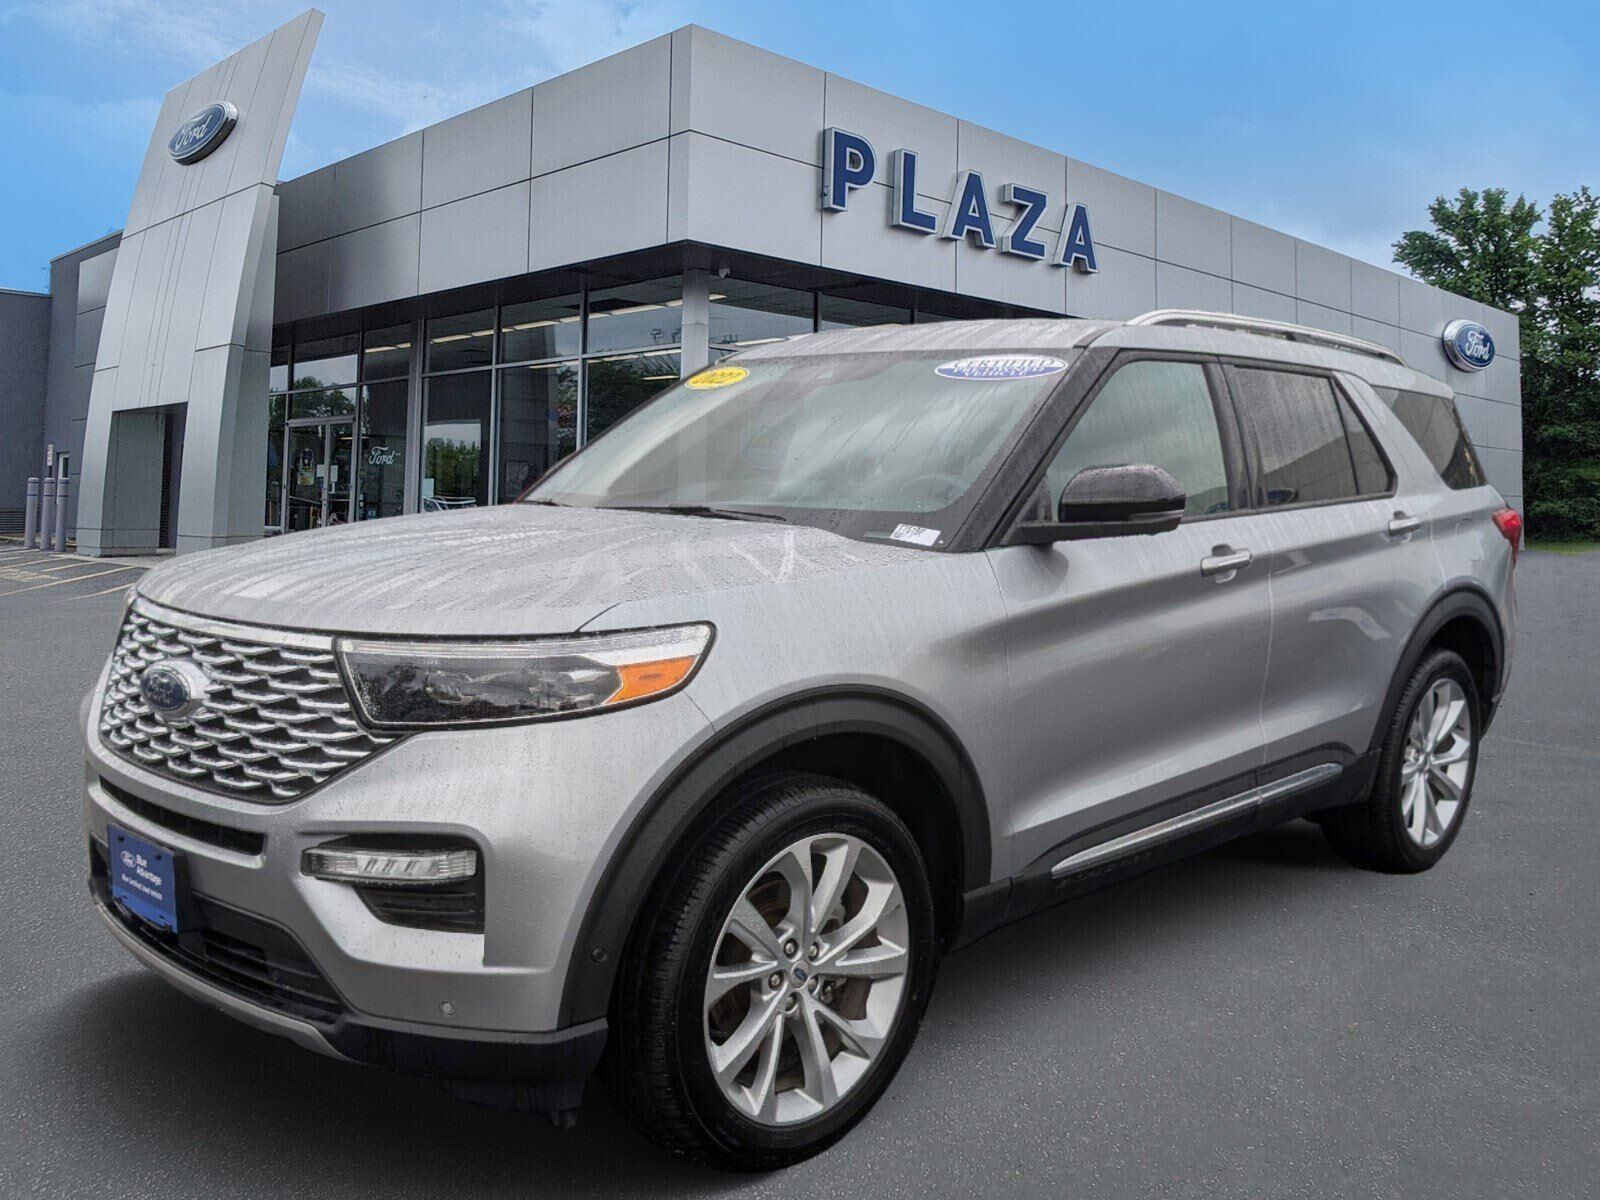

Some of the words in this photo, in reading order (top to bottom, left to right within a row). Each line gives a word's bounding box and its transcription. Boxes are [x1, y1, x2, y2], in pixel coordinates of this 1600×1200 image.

[174, 113, 213, 151] Ford
[822, 127, 1098, 274] PLAZA
[1465, 330, 1490, 361] Ford
[368, 446, 396, 465] Ford
